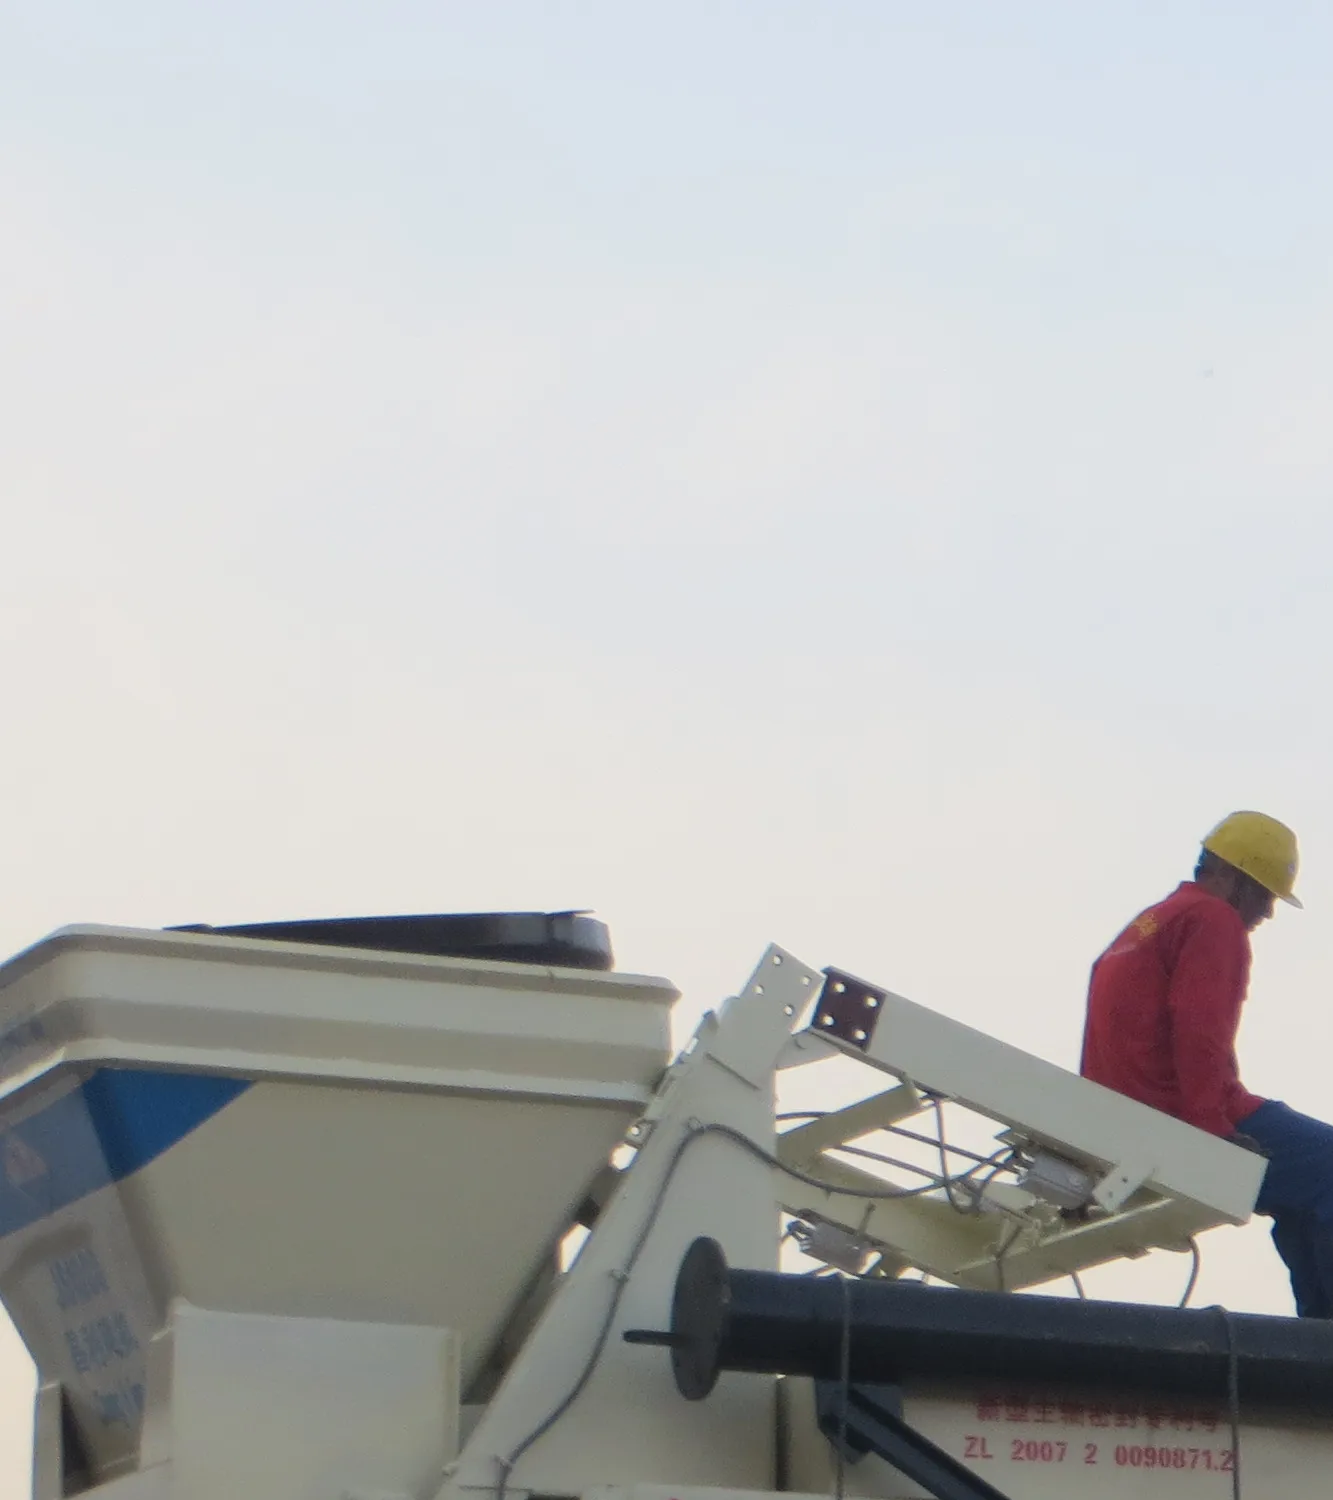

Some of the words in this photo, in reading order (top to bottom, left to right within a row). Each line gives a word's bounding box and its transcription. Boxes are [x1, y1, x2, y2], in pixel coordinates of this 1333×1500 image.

[963, 1435, 993, 1459] ZL
[1010, 1438, 1067, 1462] 2007
[1084, 1442, 1098, 1465] 2
[1113, 1444, 1235, 1472] 0090871.2
